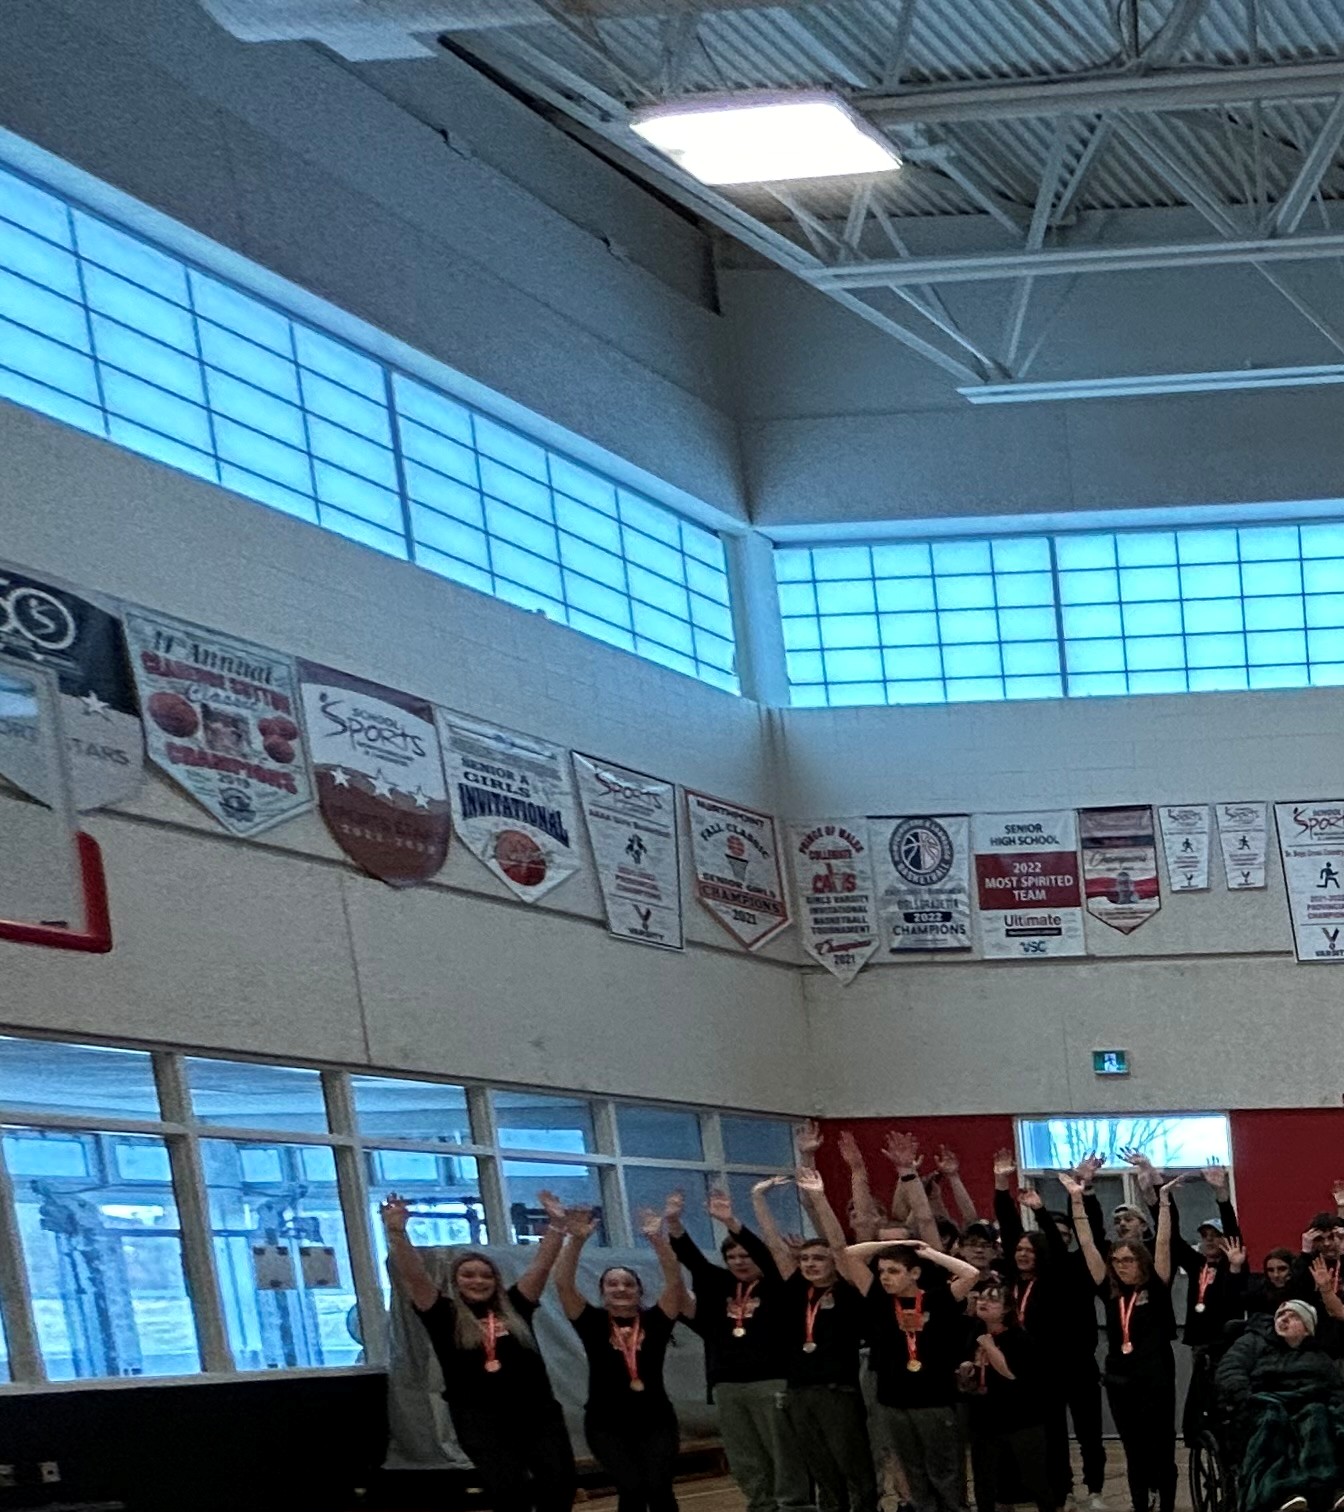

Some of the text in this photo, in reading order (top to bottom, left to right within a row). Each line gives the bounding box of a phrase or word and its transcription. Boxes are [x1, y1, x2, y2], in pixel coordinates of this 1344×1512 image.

[463, 771, 531, 798] GIRLS
[458, 783, 570, 848] INVITATIONAL
[700, 823, 724, 841] FALL
[1004, 823, 1043, 834] SENIOR
[990, 835, 1060, 846] HIGH SCHOOL
[898, 863, 950, 884] BASKETBALL
[1013, 862, 1042, 874] 2022
[985, 874, 1074, 889] MOST SPIRITED
[702, 884, 780, 915] CHAMPIONS
[1013, 889, 1046, 901] TEAM
[732, 908, 757, 925] 2021
[914, 913, 943, 922] 2022
[1004, 914, 1062, 927] Ultimate
[893, 924, 966, 936] CHAMPIONS
